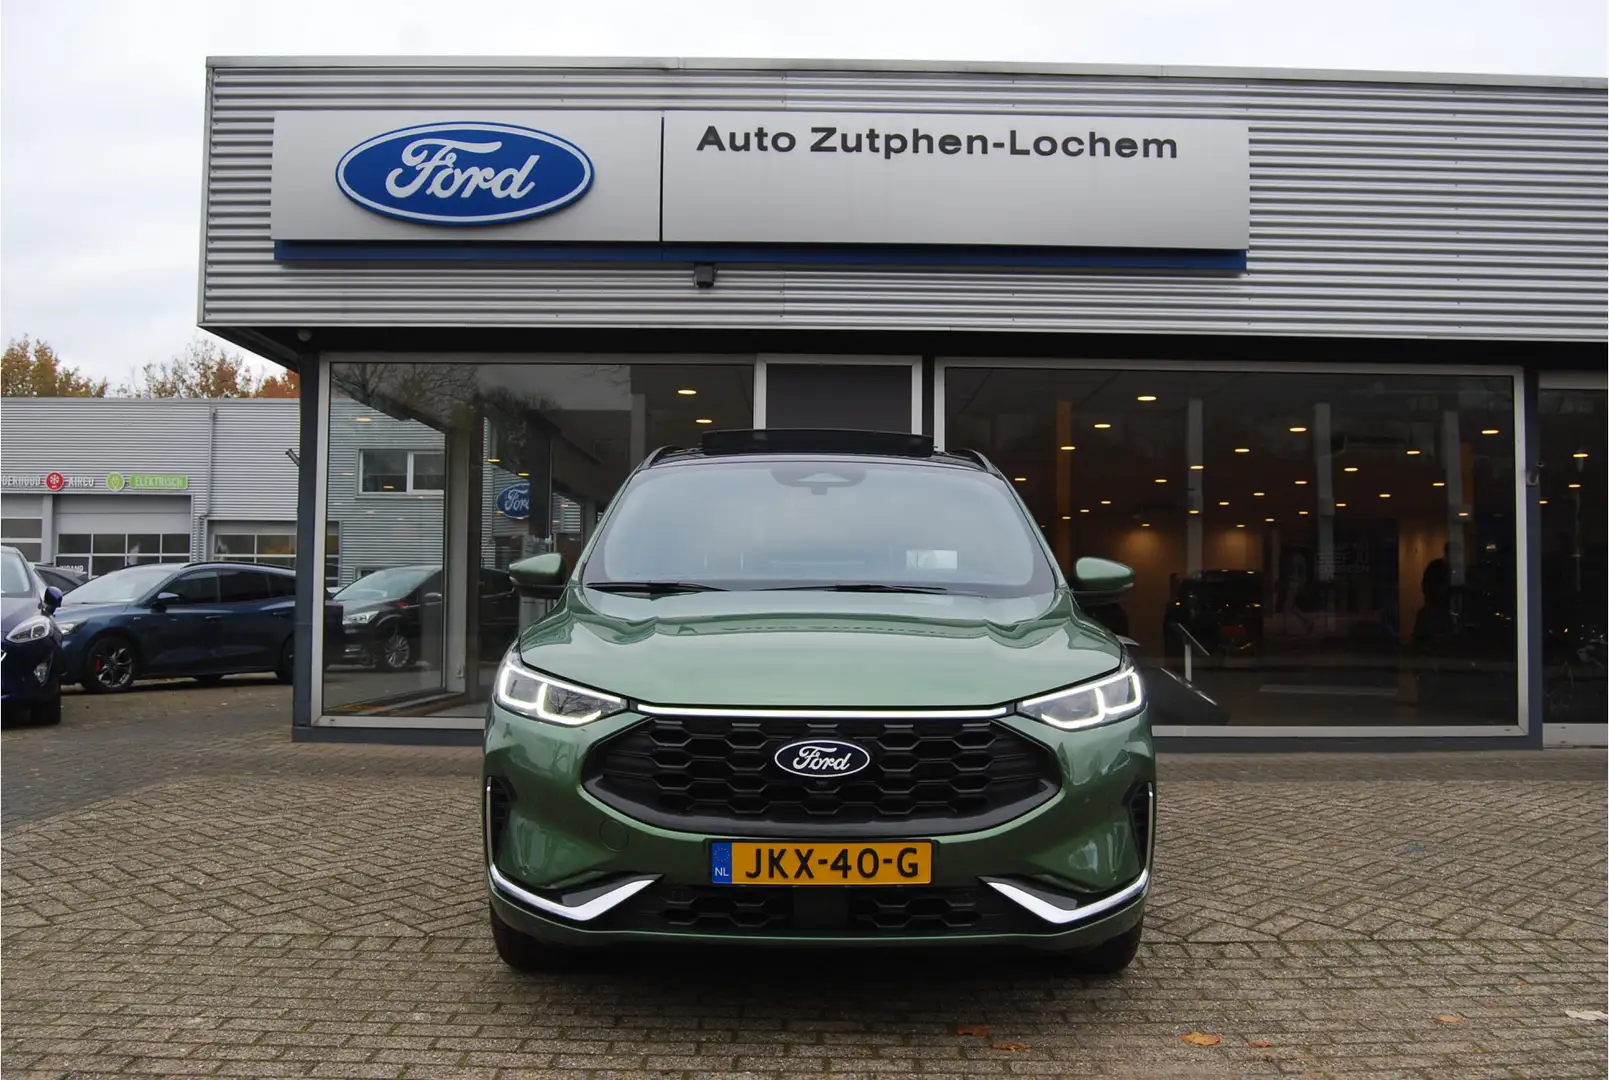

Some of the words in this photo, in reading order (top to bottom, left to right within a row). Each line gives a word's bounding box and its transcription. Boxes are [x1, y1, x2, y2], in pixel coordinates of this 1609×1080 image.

[696, 125, 796, 153] Auto
[810, 126, 1179, 160] Zutphen-Lochem
[385, 138, 541, 200] Ford
[68, 477, 95, 487] AIRCO
[135, 476, 183, 488] ELEKTRISCH
[792, 745, 852, 771] Ford
[714, 867, 729, 877] NL
[745, 847, 919, 879] JKX-40-G
